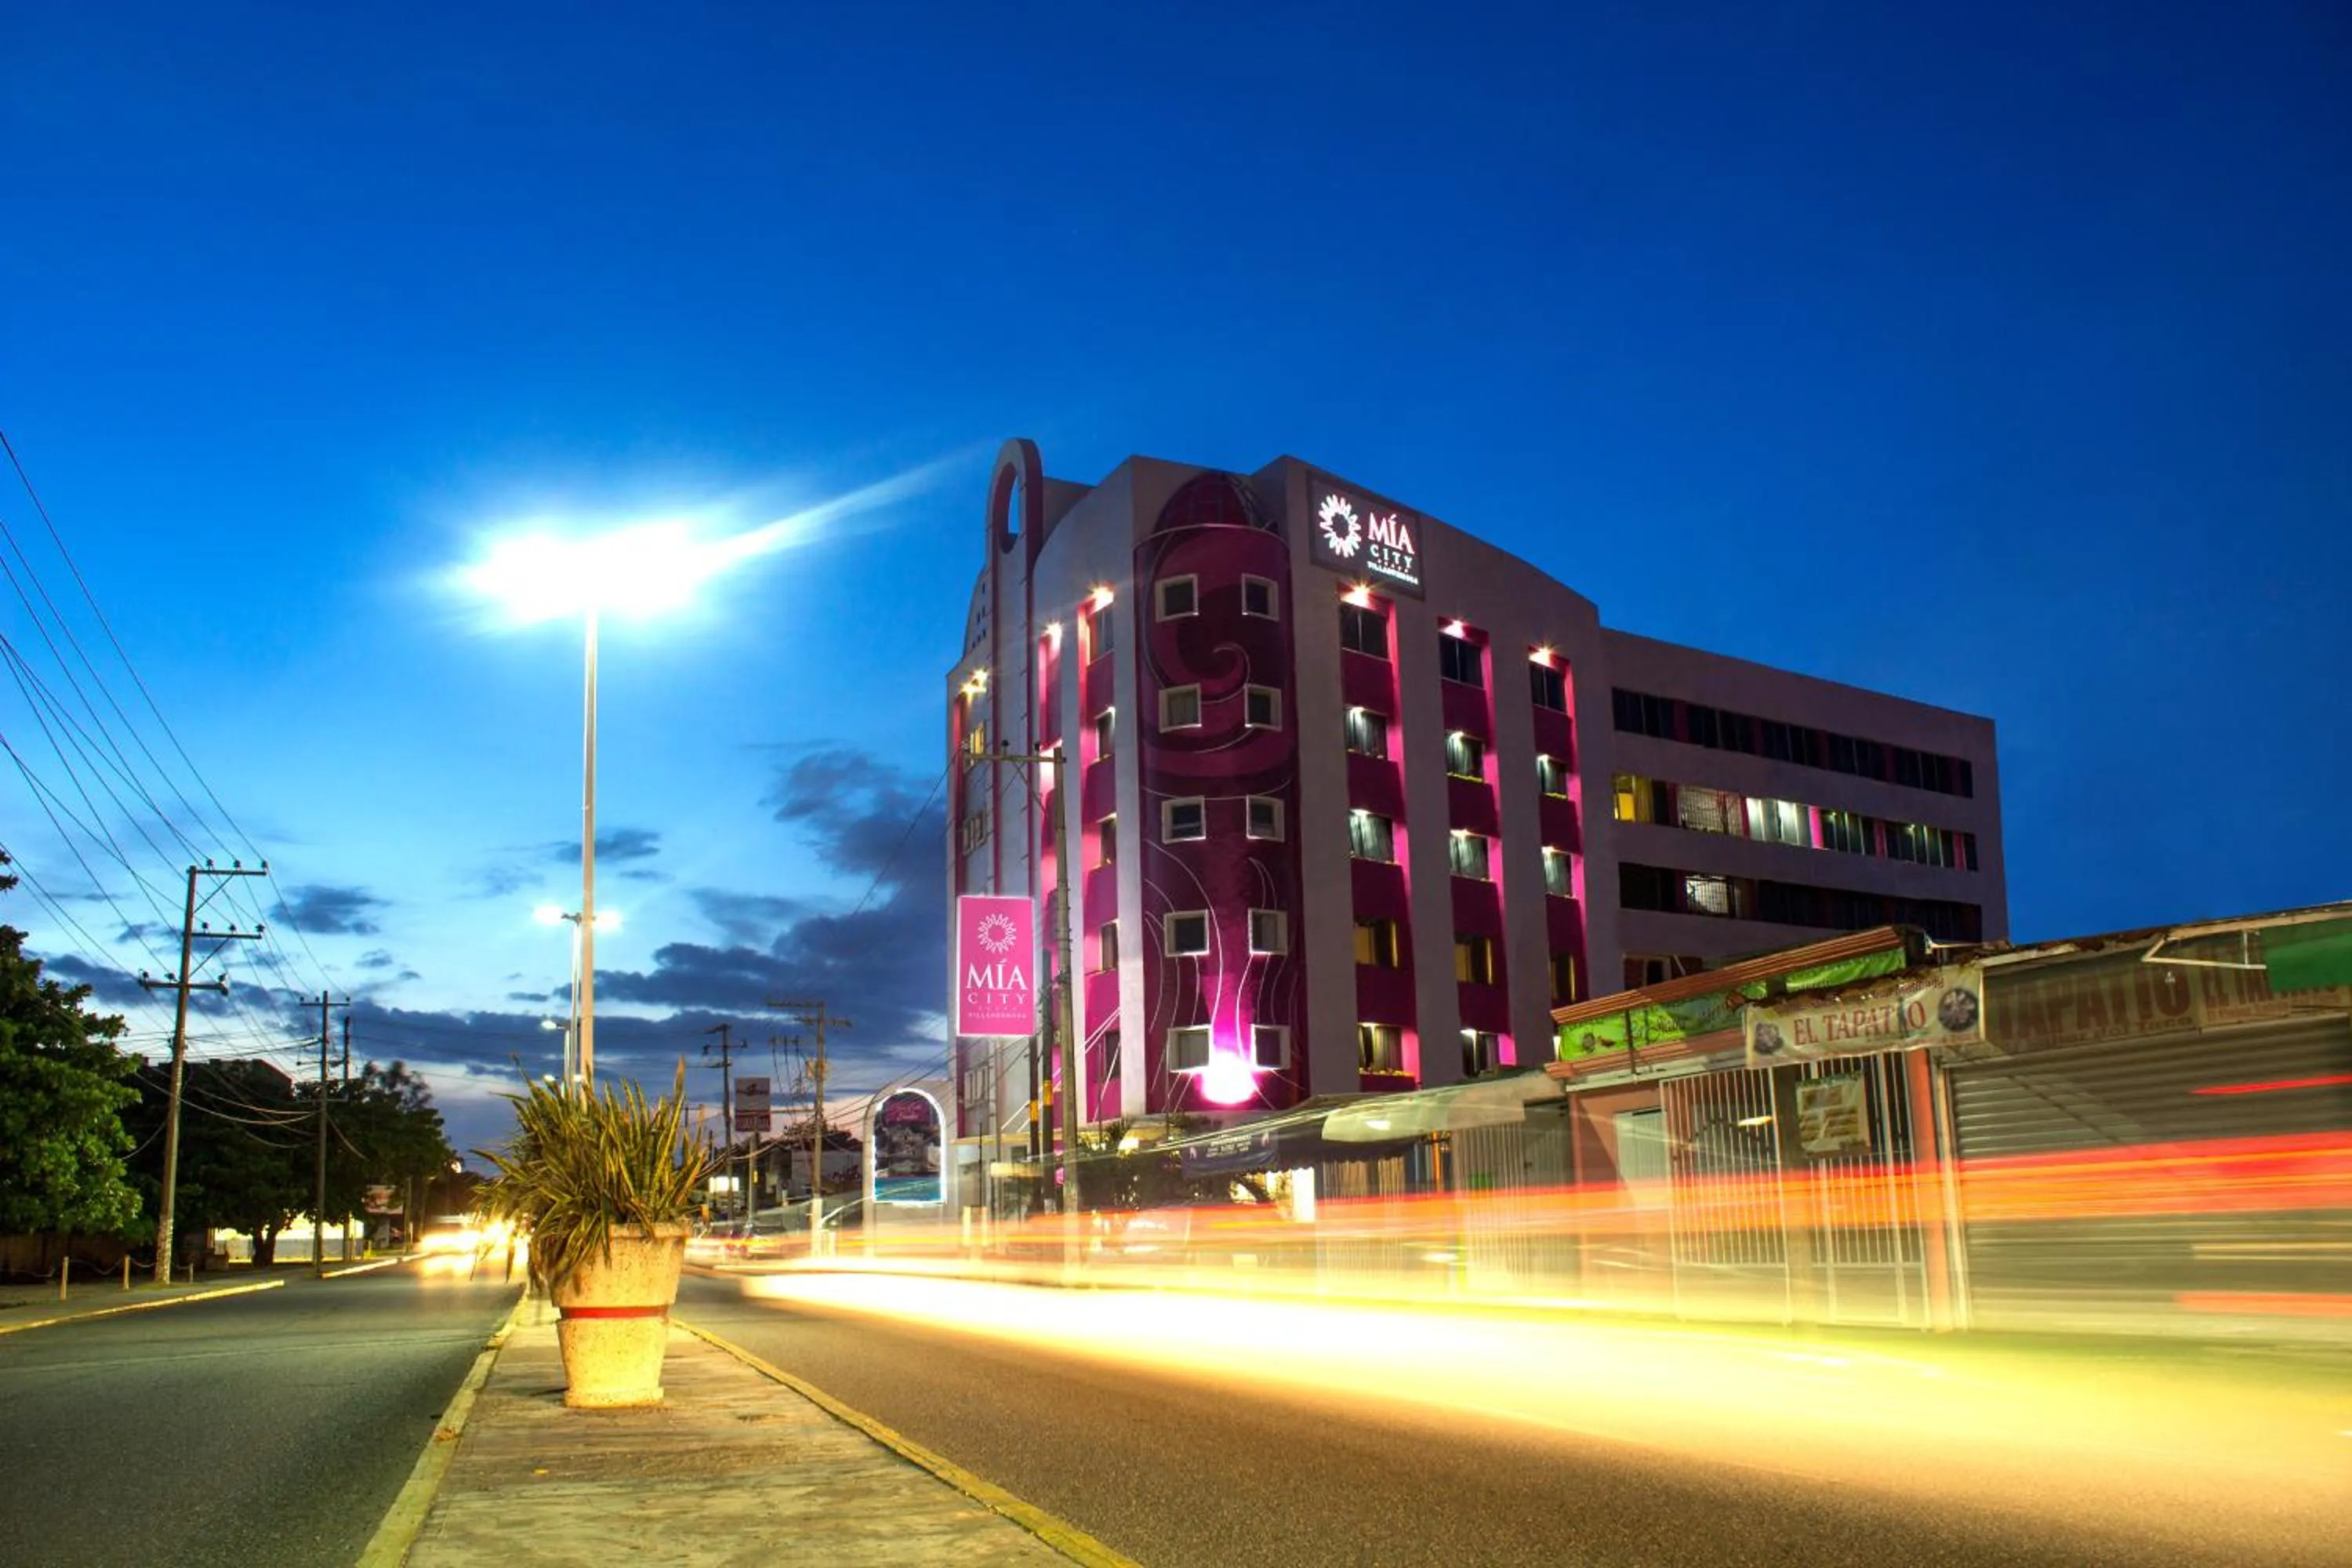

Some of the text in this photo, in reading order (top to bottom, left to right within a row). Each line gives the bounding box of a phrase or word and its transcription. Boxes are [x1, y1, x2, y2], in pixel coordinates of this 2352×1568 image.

[1368, 512, 1415, 554] MÍA
[1370, 544, 1413, 568] CITY
[966, 959, 1029, 991] MÍA
[967, 993, 1027, 1004] CITY
[1793, 1017, 1820, 1047] EL
